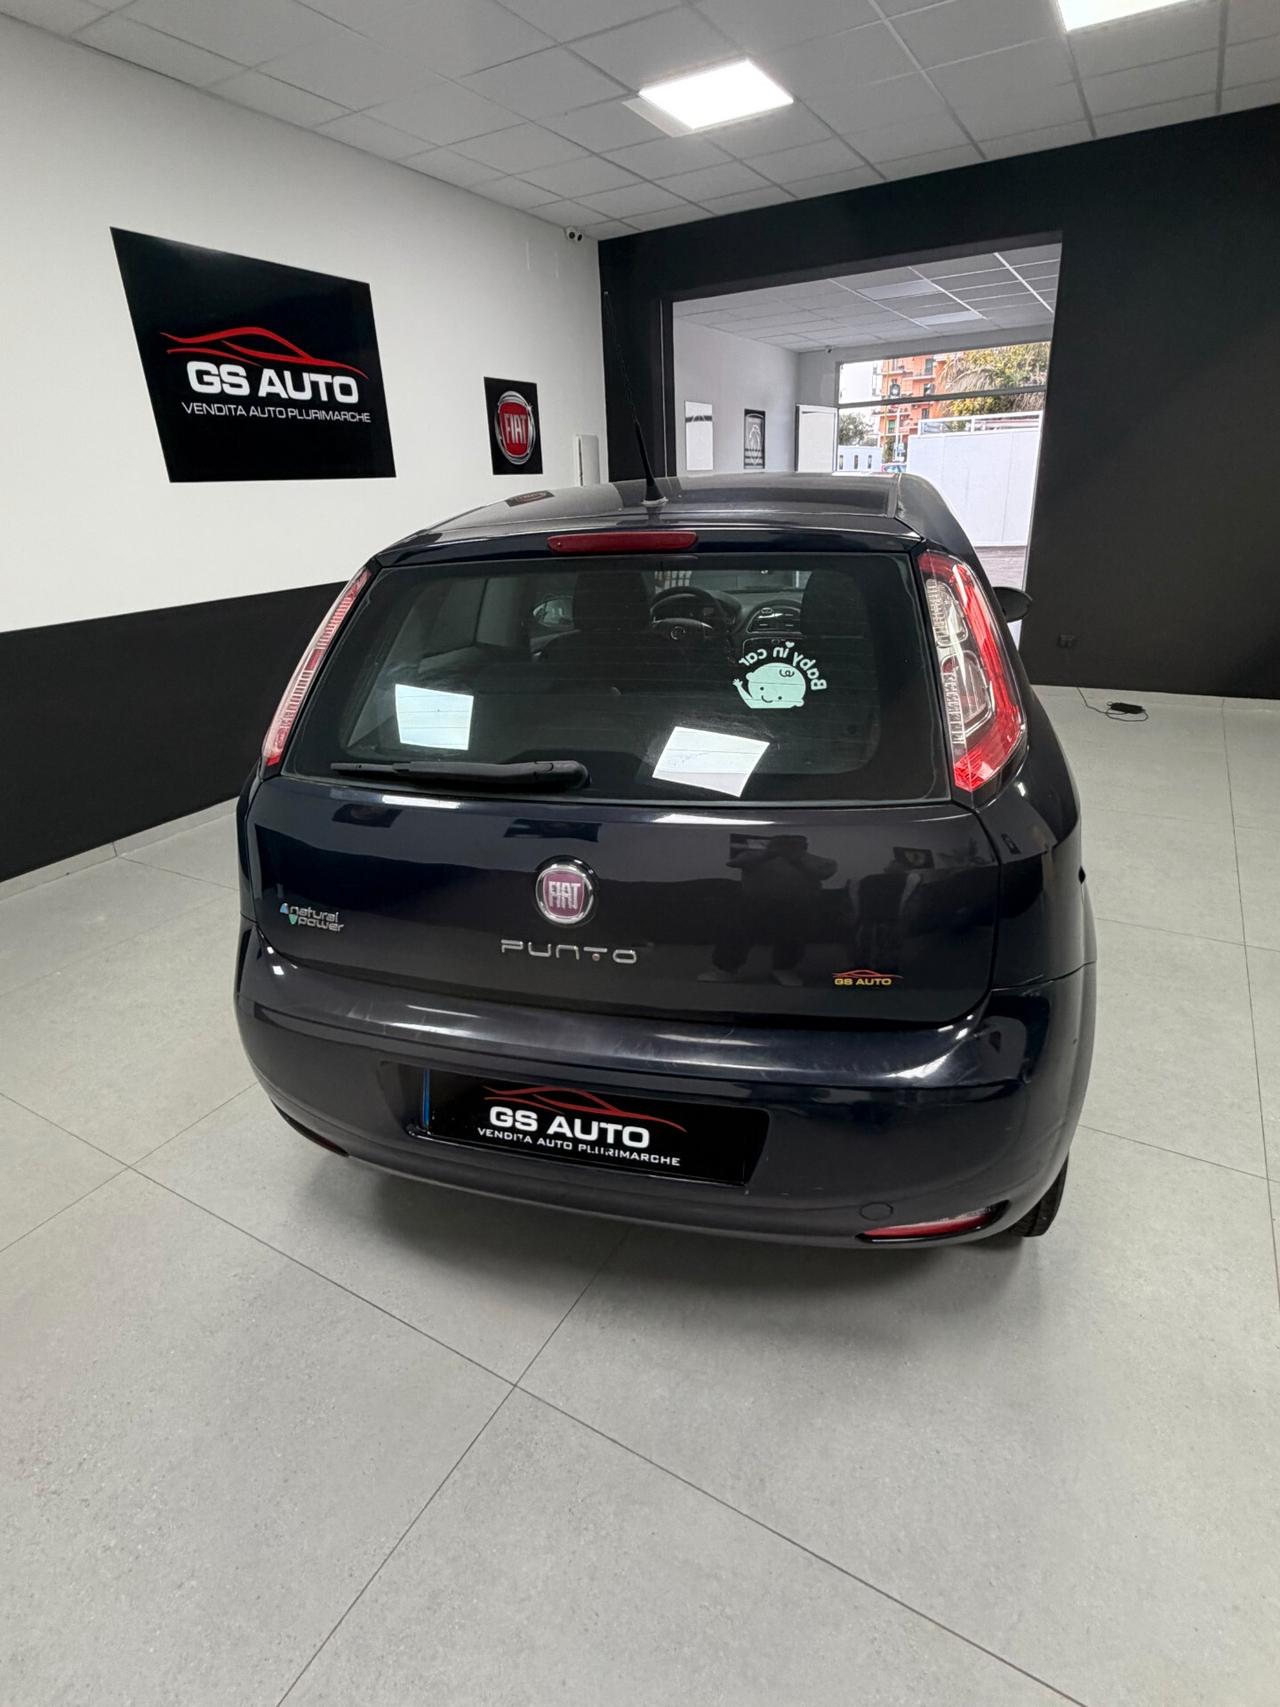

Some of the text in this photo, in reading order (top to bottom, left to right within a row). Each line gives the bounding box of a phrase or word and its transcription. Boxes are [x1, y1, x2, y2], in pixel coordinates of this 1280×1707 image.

[186, 360, 359, 404] GS AUTO
[181, 401, 371, 423] VENDITA AUTO PLURIMARCHE
[503, 412, 527, 444] FIAT
[548, 880, 581, 910] FIAT
[289, 905, 339, 923] natural
[297, 916, 344, 932] power
[500, 939, 637, 964] PUNTO
[834, 978, 892, 986] GS AUTO
[477, 1127, 533, 1144] VENDITA
[536, 1137, 573, 1151] AUTO
[489, 1106, 650, 1149] GS AUTO
